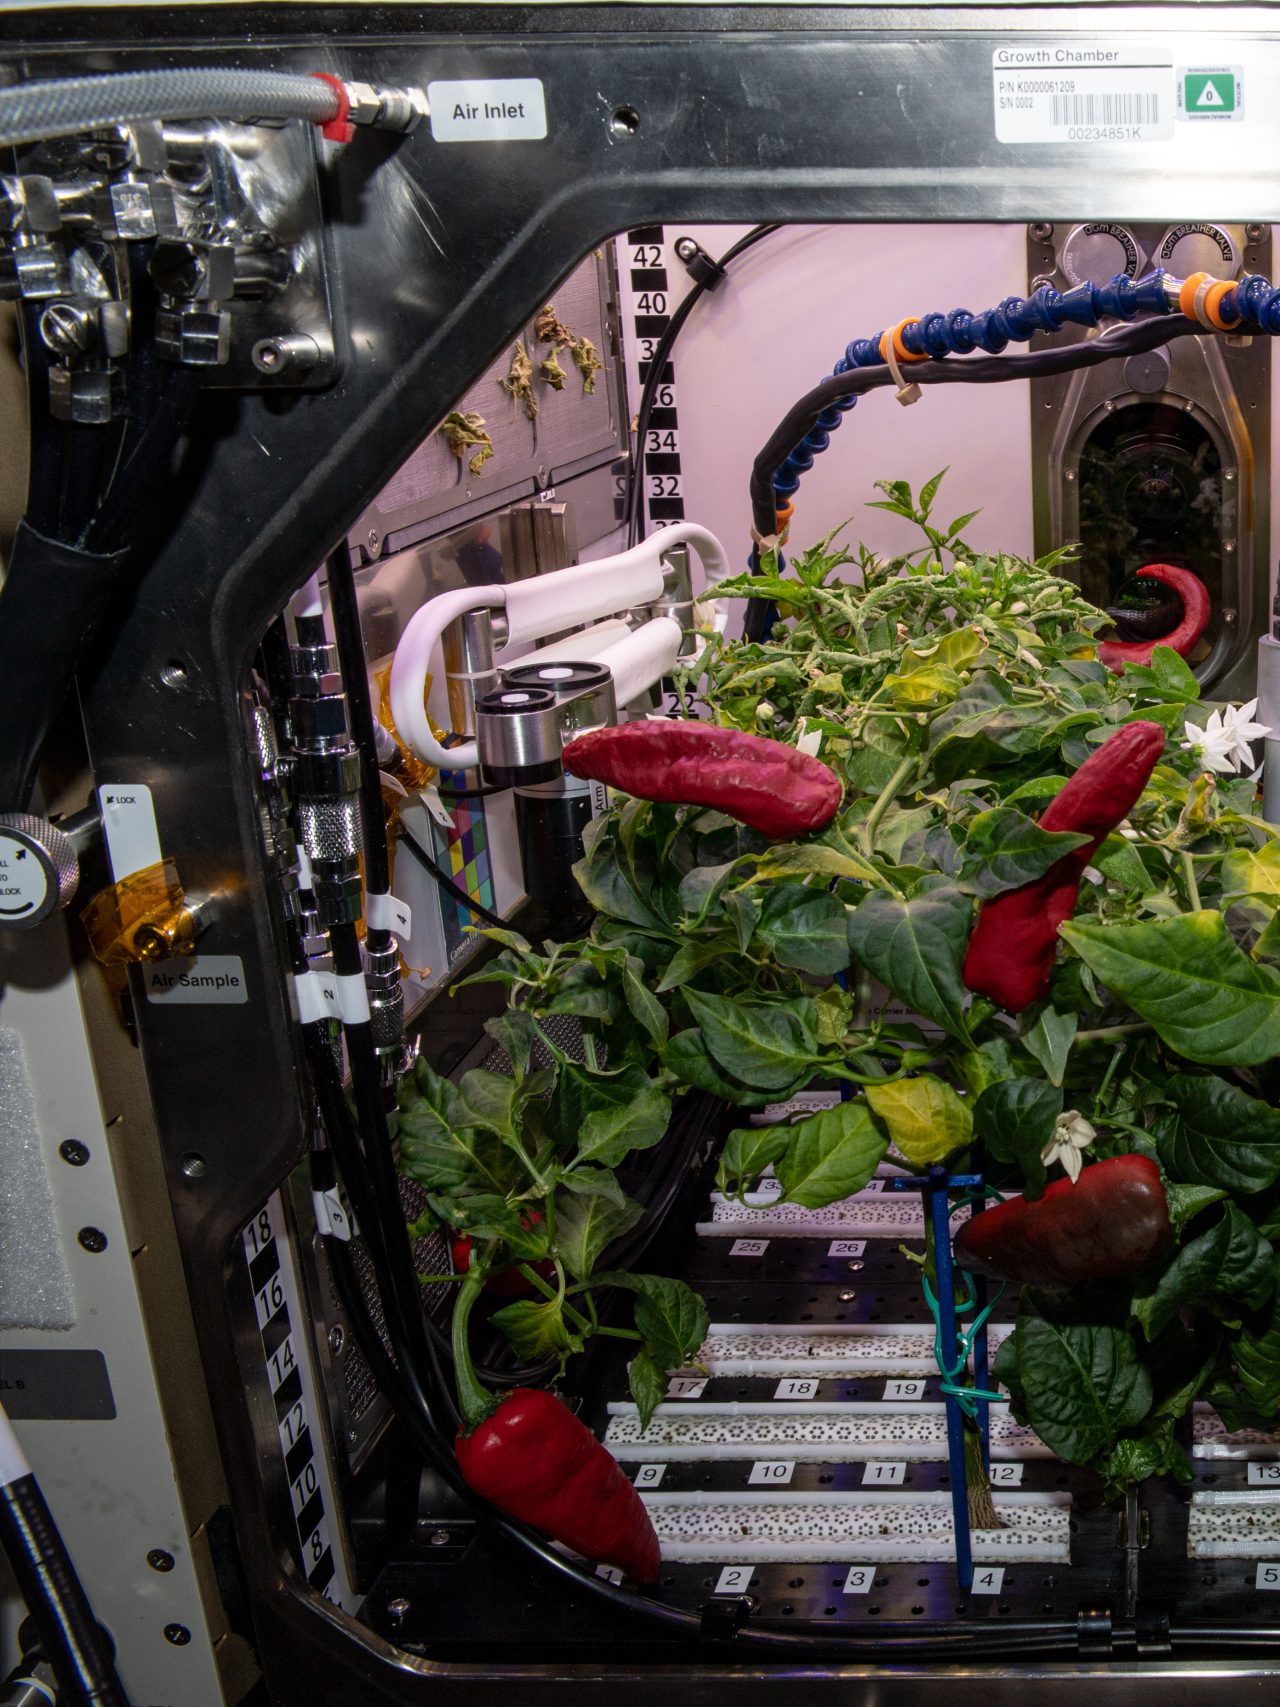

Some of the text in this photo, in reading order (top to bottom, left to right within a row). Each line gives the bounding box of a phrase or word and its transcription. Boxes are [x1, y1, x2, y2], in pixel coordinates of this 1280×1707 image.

[998, 49, 1119, 63] Growth Chamber
[999, 81, 1075, 93] P/N K0000061209
[999, 97, 1034, 109] S/N 0002
[453, 102, 525, 120] Air Inlet
[1069, 127, 1142, 140] 00234851K
[1110, 226, 1137, 261] BREATHER
[1177, 224, 1216, 238] BREATHER
[1215, 233, 1233, 261] VALVE
[633, 246, 662, 267] 42
[637, 293, 666, 314] 40
[648, 431, 677, 452] 34
[652, 476, 680, 497] 32
[668, 693, 696, 713] 22
[116, 796, 136, 804] LOCK
[151, 973, 240, 990] Air Sample
[873, 1007, 904, 1015] Crrier
[248, 1210, 271, 1254] 18
[740, 1242, 763, 1252] 25
[837, 1243, 859, 1253] 26
[260, 1274, 283, 1320] 16
[272, 1338, 294, 1384] 14
[16, 1380, 26, 1390] B
[675, 1381, 702, 1394] 17
[786, 1382, 811, 1394] 18
[893, 1383, 918, 1395] 19
[283, 1402, 306, 1446] 12
[641, 1468, 658, 1481] 9
[762, 1465, 787, 1479] 10
[875, 1466, 897, 1479] 11
[990, 1467, 1015, 1481] 12
[295, 1463, 316, 1506] 10
[311, 1529, 323, 1562] 8
[725, 1571, 743, 1587] 2
[849, 1571, 866, 1587] 3
[978, 1572, 995, 1587] 4
[1263, 1568, 1279, 1583] 5
